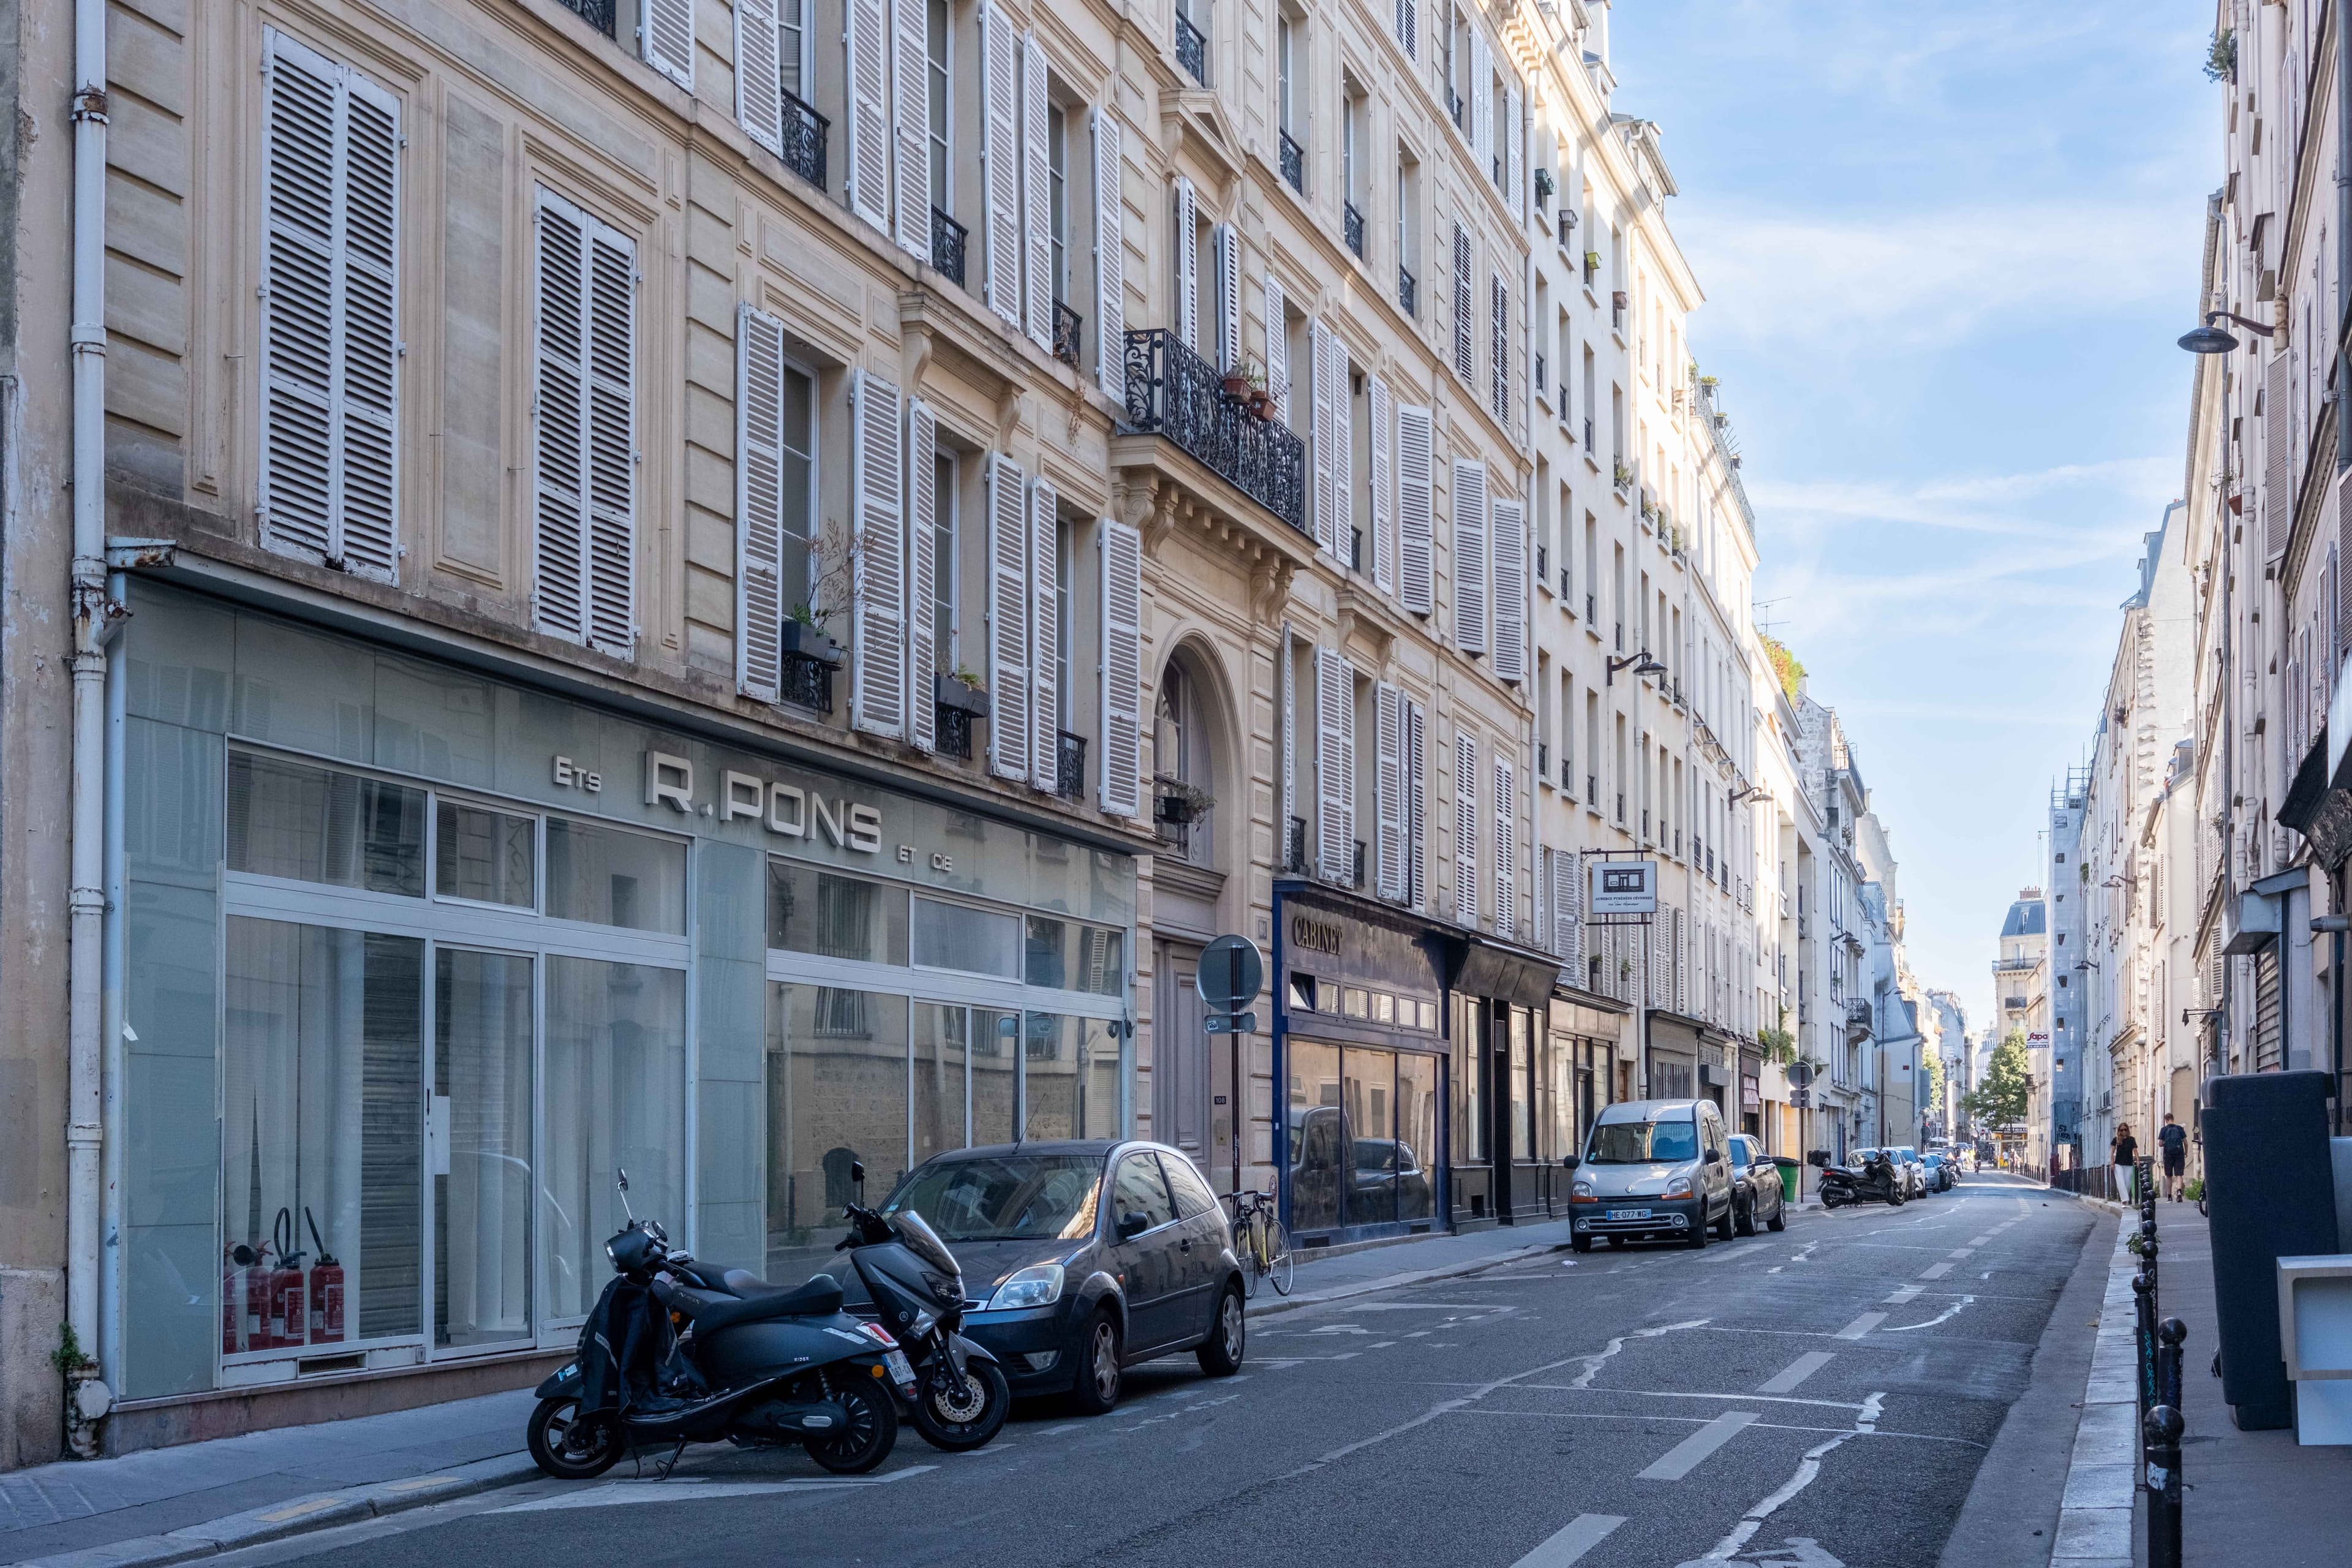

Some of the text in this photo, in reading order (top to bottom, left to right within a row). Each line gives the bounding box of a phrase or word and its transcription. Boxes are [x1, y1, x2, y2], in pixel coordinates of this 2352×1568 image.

[897, 845, 917, 863] ET
[1294, 916, 1343, 956] CABINET
[1611, 1210, 1646, 1219] HE-077-WG
